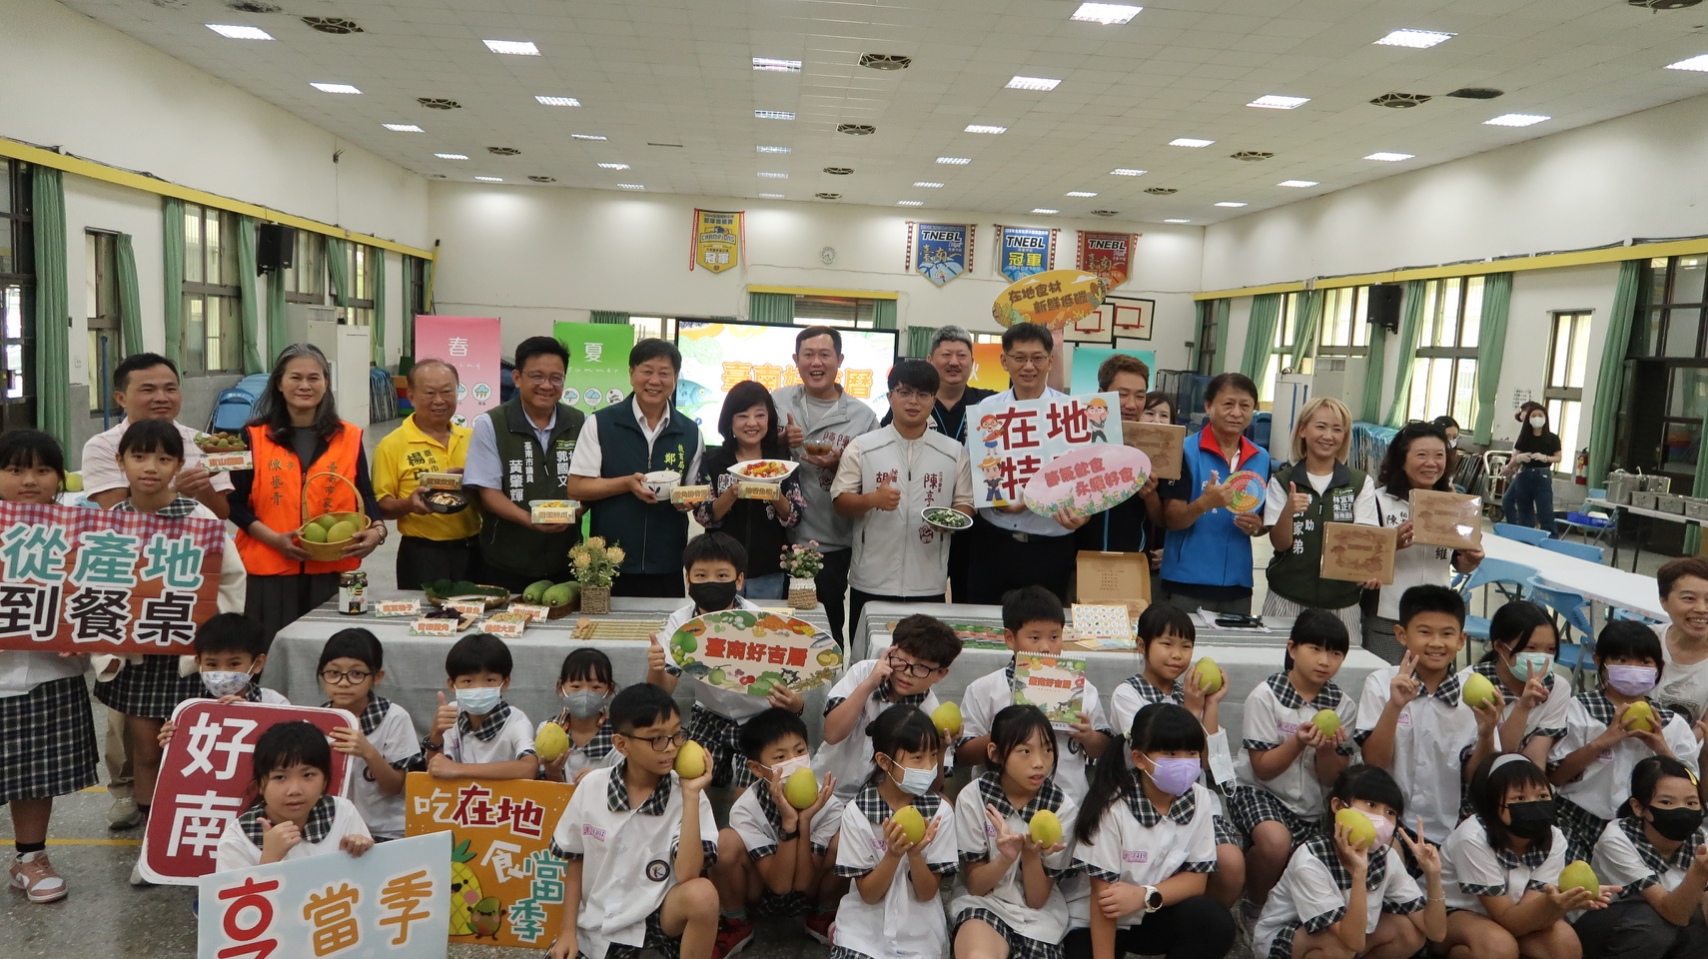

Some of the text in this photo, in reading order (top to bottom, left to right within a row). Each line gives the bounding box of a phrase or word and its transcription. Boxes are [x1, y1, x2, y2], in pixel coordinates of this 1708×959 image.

[922, 230, 962, 242] TNEBL
[1006, 235, 1045, 248] TNEBL
[1088, 239, 1127, 250] TNEBL
[1009, 252, 1042, 267] 冠軍
[1008, 280, 1062, 303] 在地食材
[448, 336, 468, 357] 春
[584, 342, 603, 362] 夏
[996, 400, 1092, 451] 在地
[1001, 455, 1060, 500] 特
[2, 525, 203, 588] 從產地
[0, 585, 196, 643] 到餐桌
[180, 712, 258, 781] 好
[166, 790, 243, 860] 南
[413, 783, 546, 841] 吃在地
